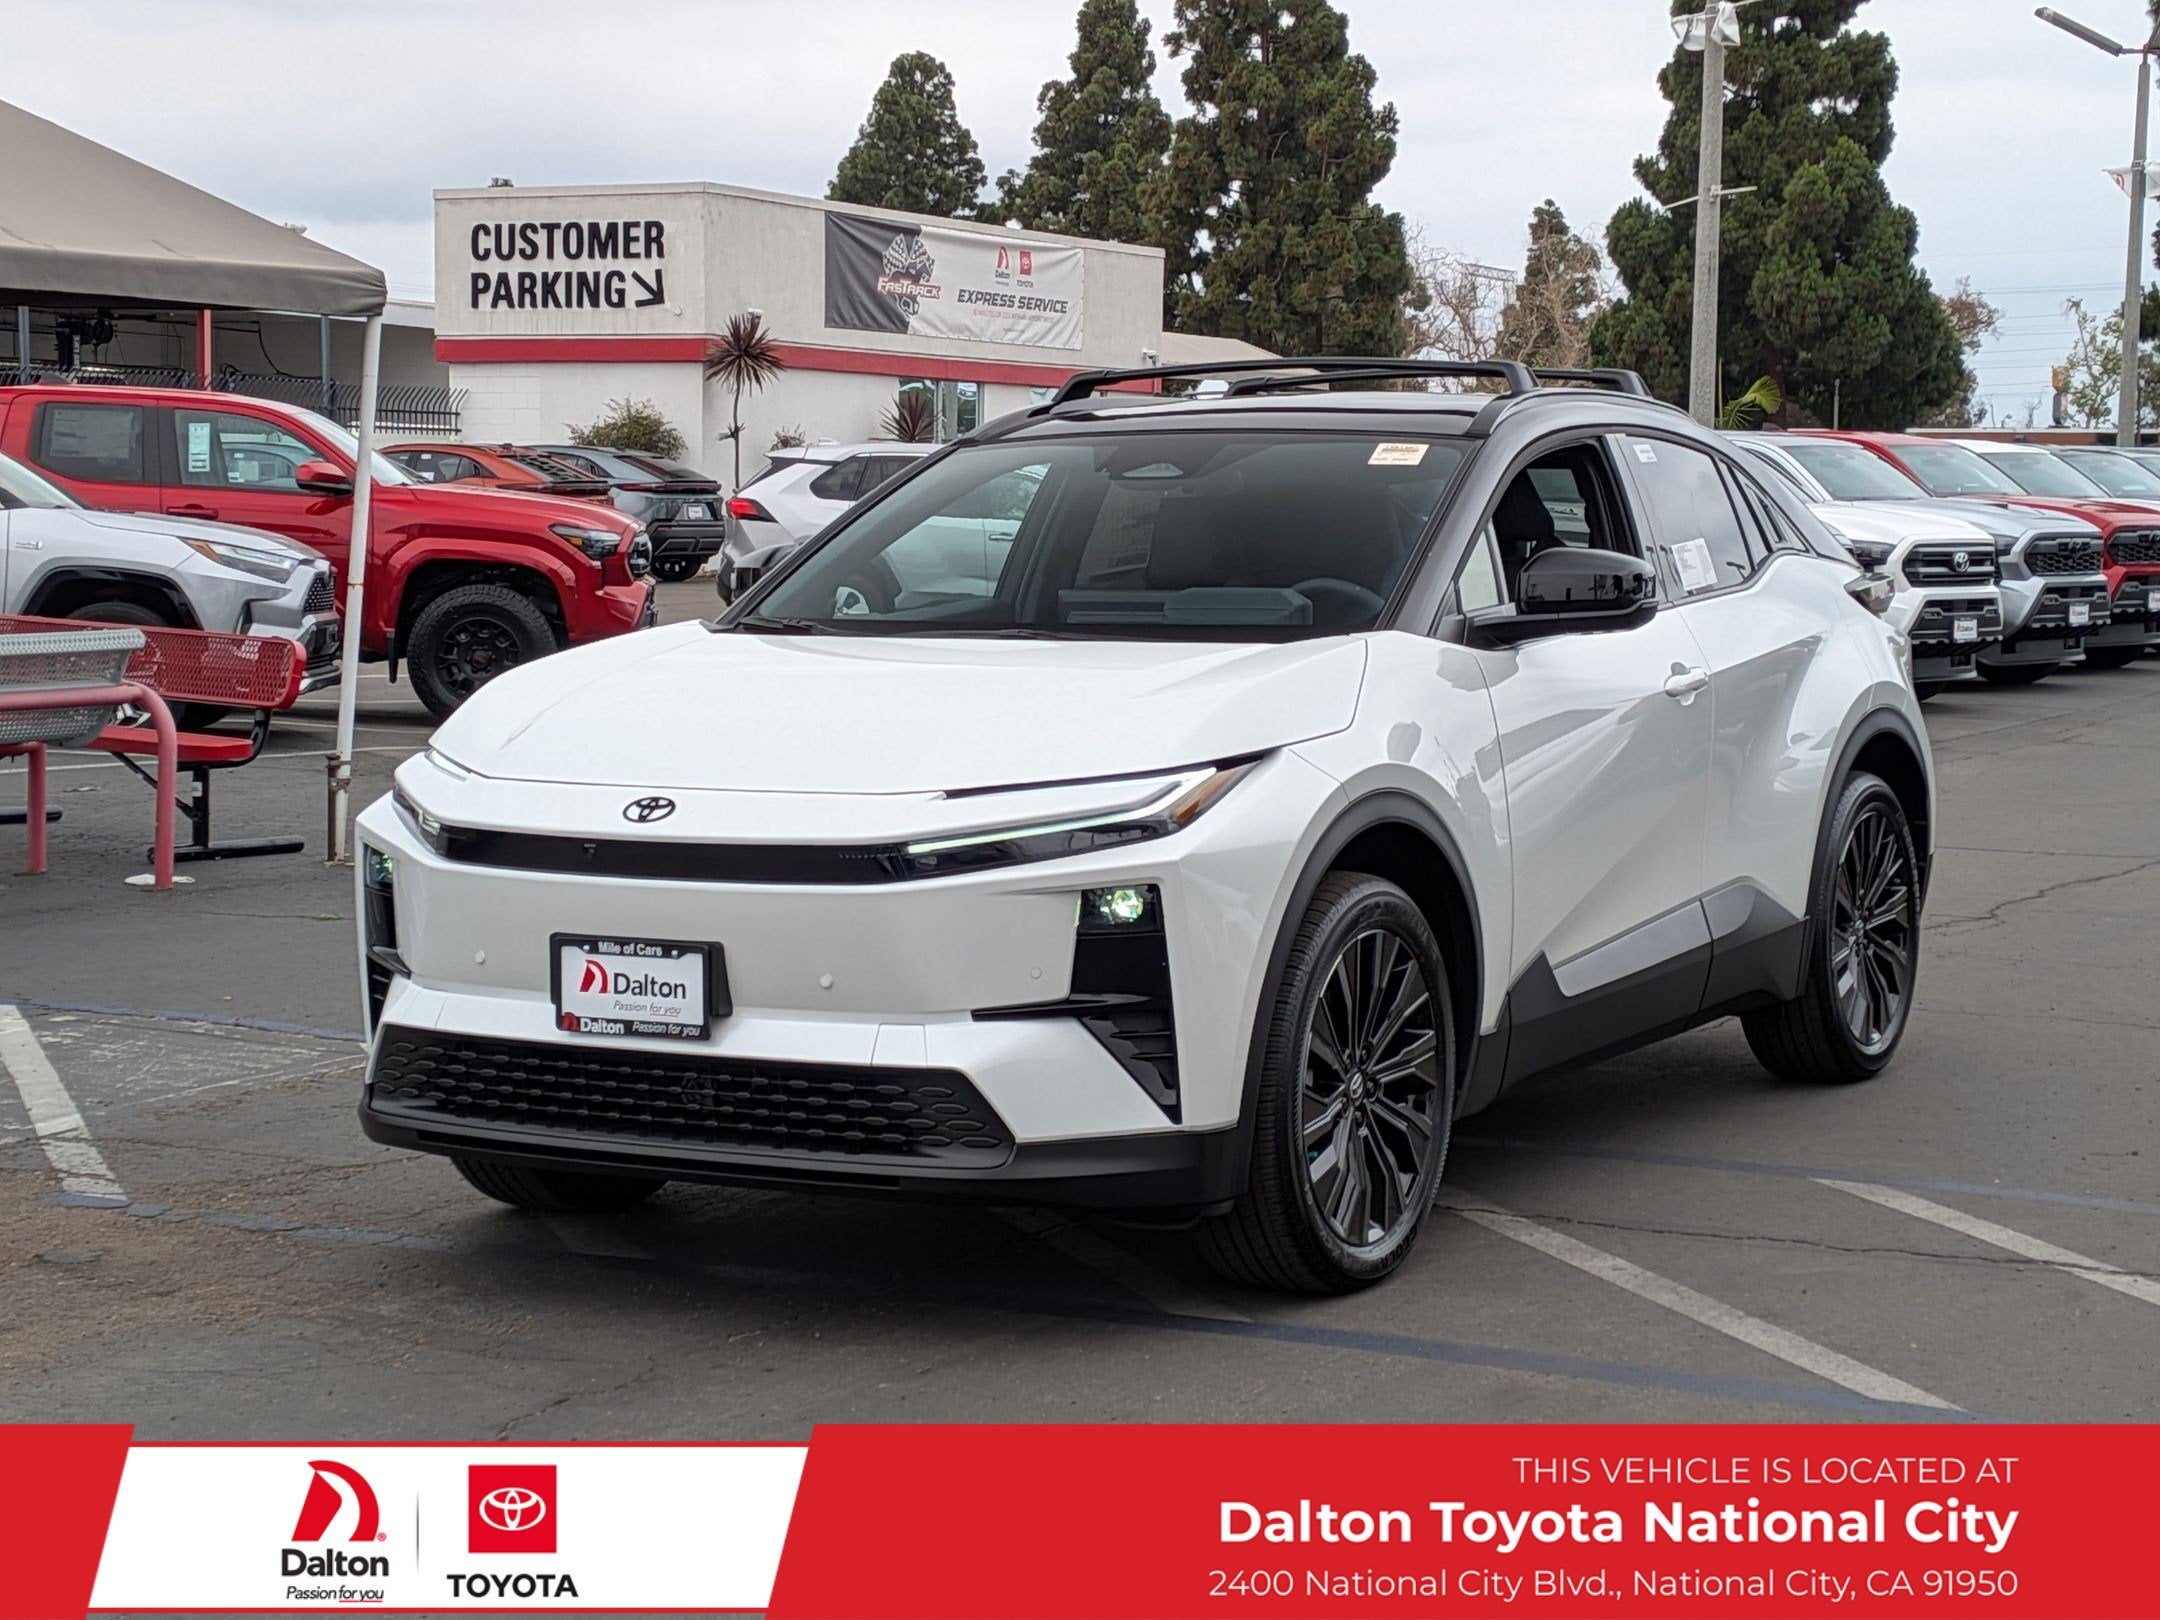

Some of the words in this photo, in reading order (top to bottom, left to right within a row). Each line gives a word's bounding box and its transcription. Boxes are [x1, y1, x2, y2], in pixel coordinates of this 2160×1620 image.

[471, 221, 665, 261] CUSTOMER
[471, 270, 626, 309] PARKING
[957, 289, 1016, 308] EXPRESS
[1017, 296, 1069, 314] SERVICE
[598, 942, 620, 954] Mile
[622, 943, 635, 954] of
[636, 944, 662, 957] Cars
[613, 972, 686, 999] Dalton
[613, 1000, 647, 1012] Passion
[649, 1002, 664, 1015] for
[664, 1006, 682, 1016] you
[580, 1018, 625, 1034] Dalton
[632, 1021, 667, 1034] Passion
[668, 1023, 682, 1035] for
[682, 1026, 701, 1038] you
